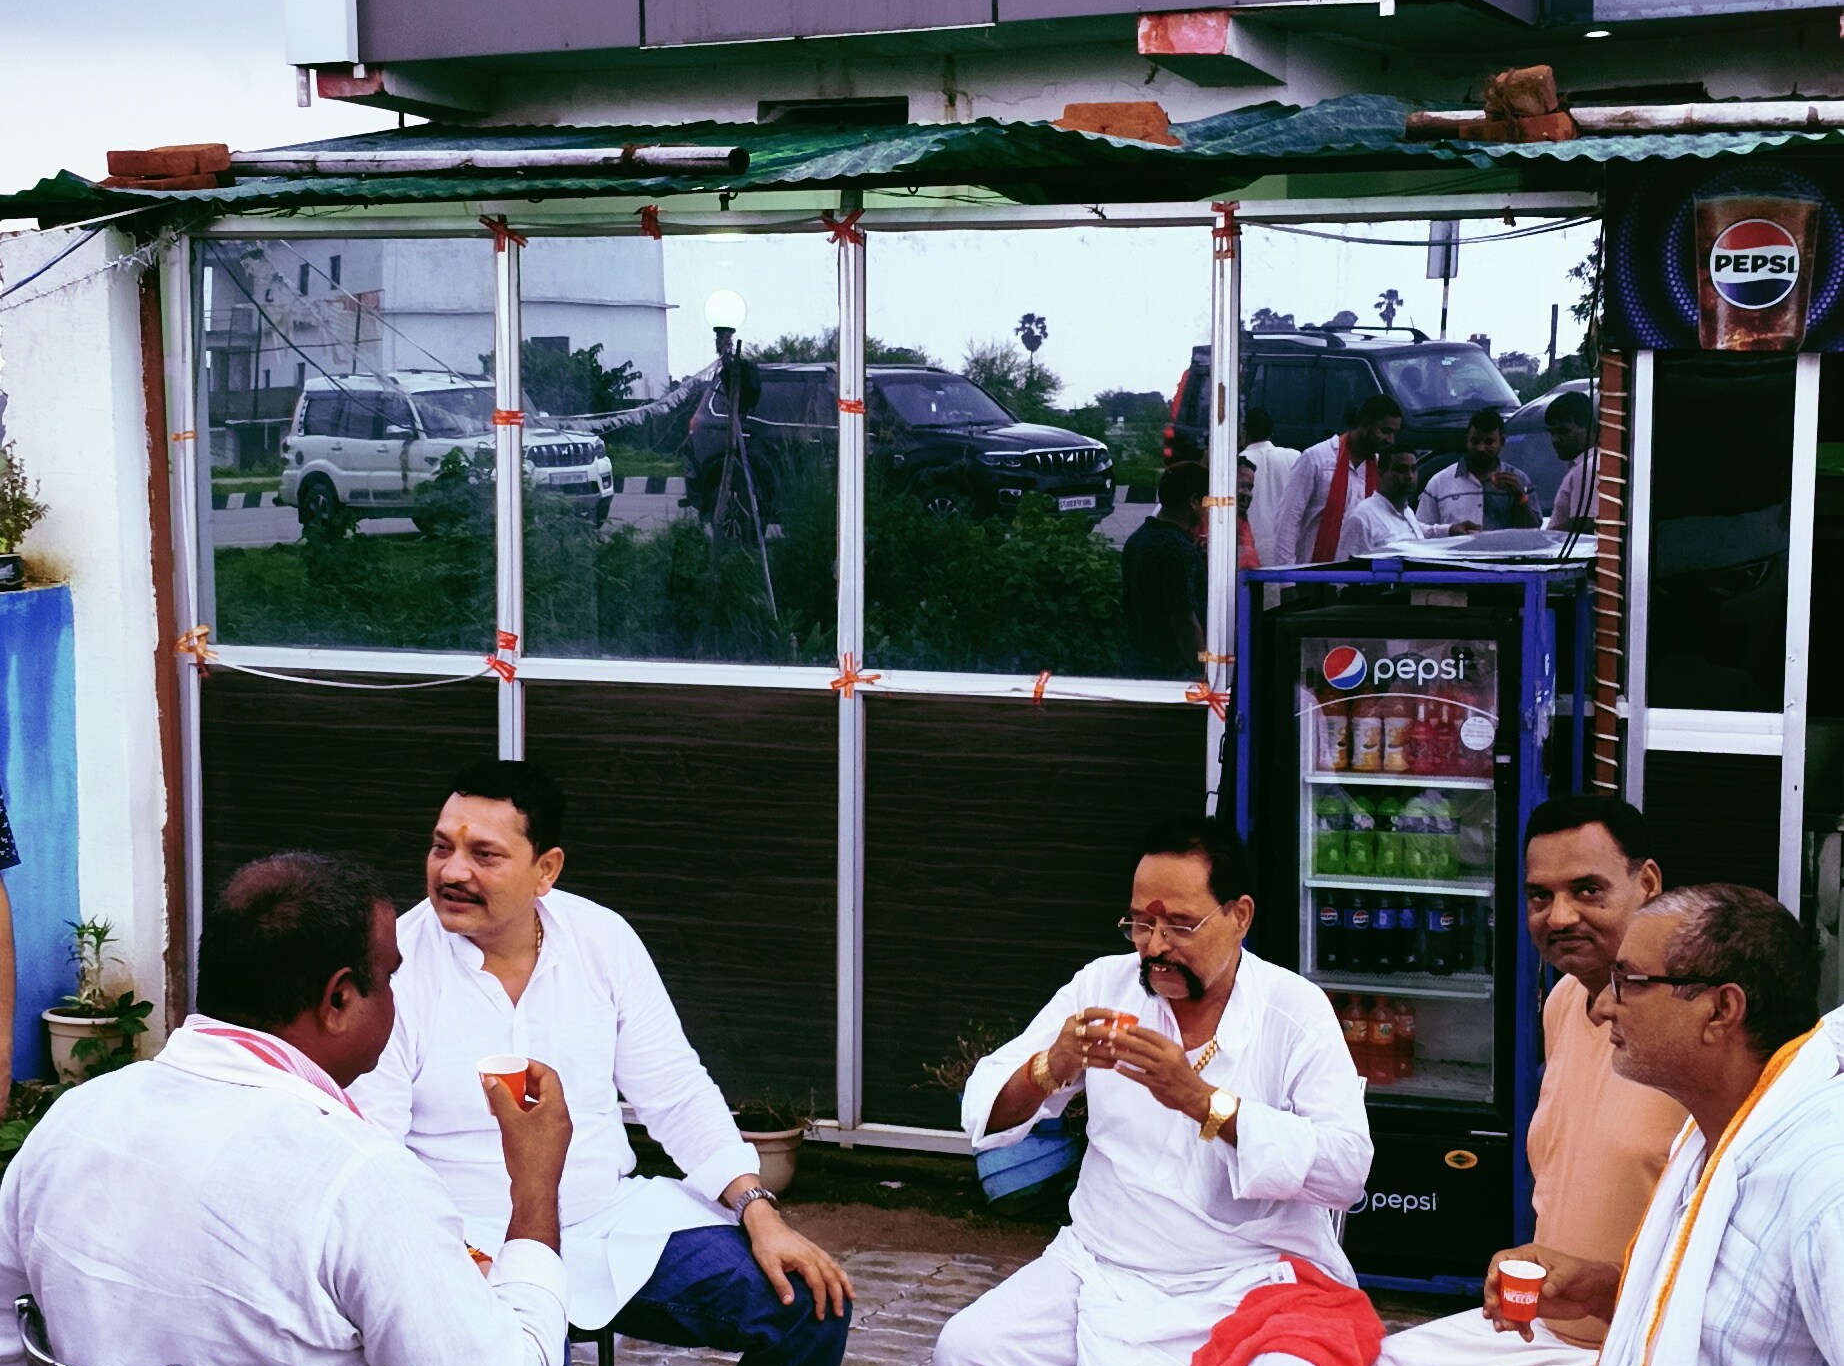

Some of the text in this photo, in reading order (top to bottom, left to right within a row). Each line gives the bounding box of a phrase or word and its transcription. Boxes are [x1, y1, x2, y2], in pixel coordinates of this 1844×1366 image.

[1714, 254, 1796, 274] PEPSI
[1373, 653, 1464, 686] pepsi
[1372, 1192, 1437, 1214] pepsi
